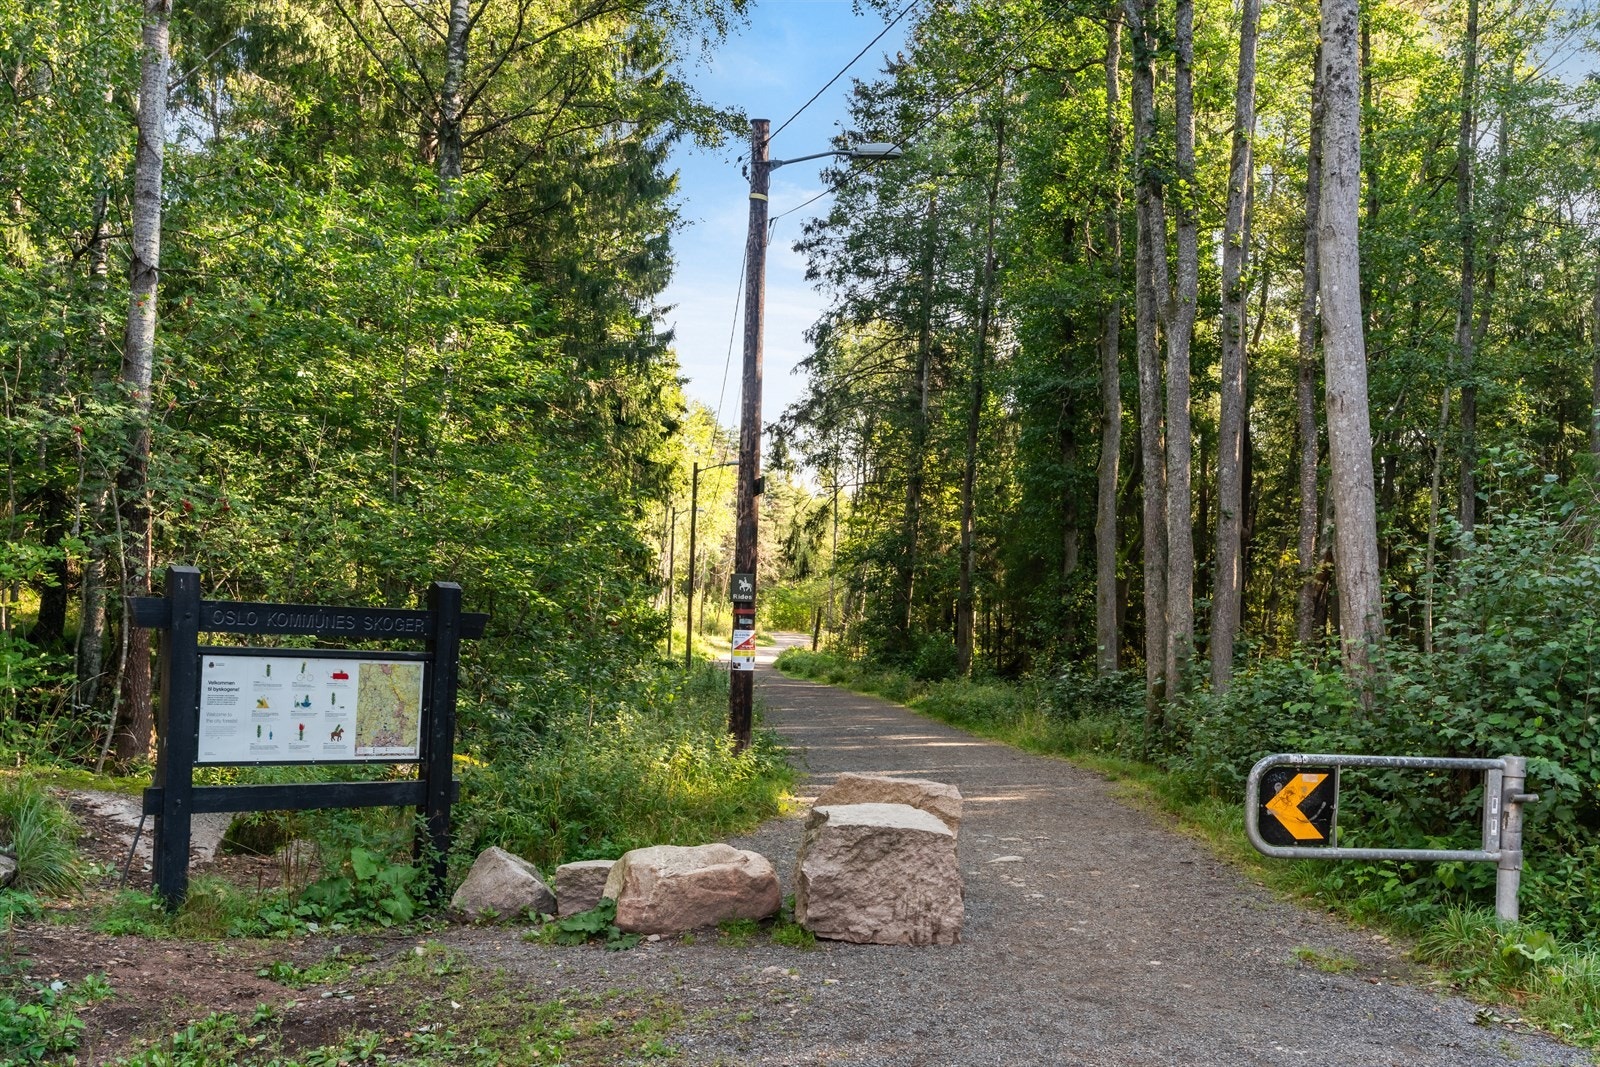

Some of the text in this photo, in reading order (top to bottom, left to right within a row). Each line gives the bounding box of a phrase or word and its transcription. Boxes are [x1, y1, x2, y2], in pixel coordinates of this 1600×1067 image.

[212, 609, 425, 633] OSLO KOMMUNES SKOGER
